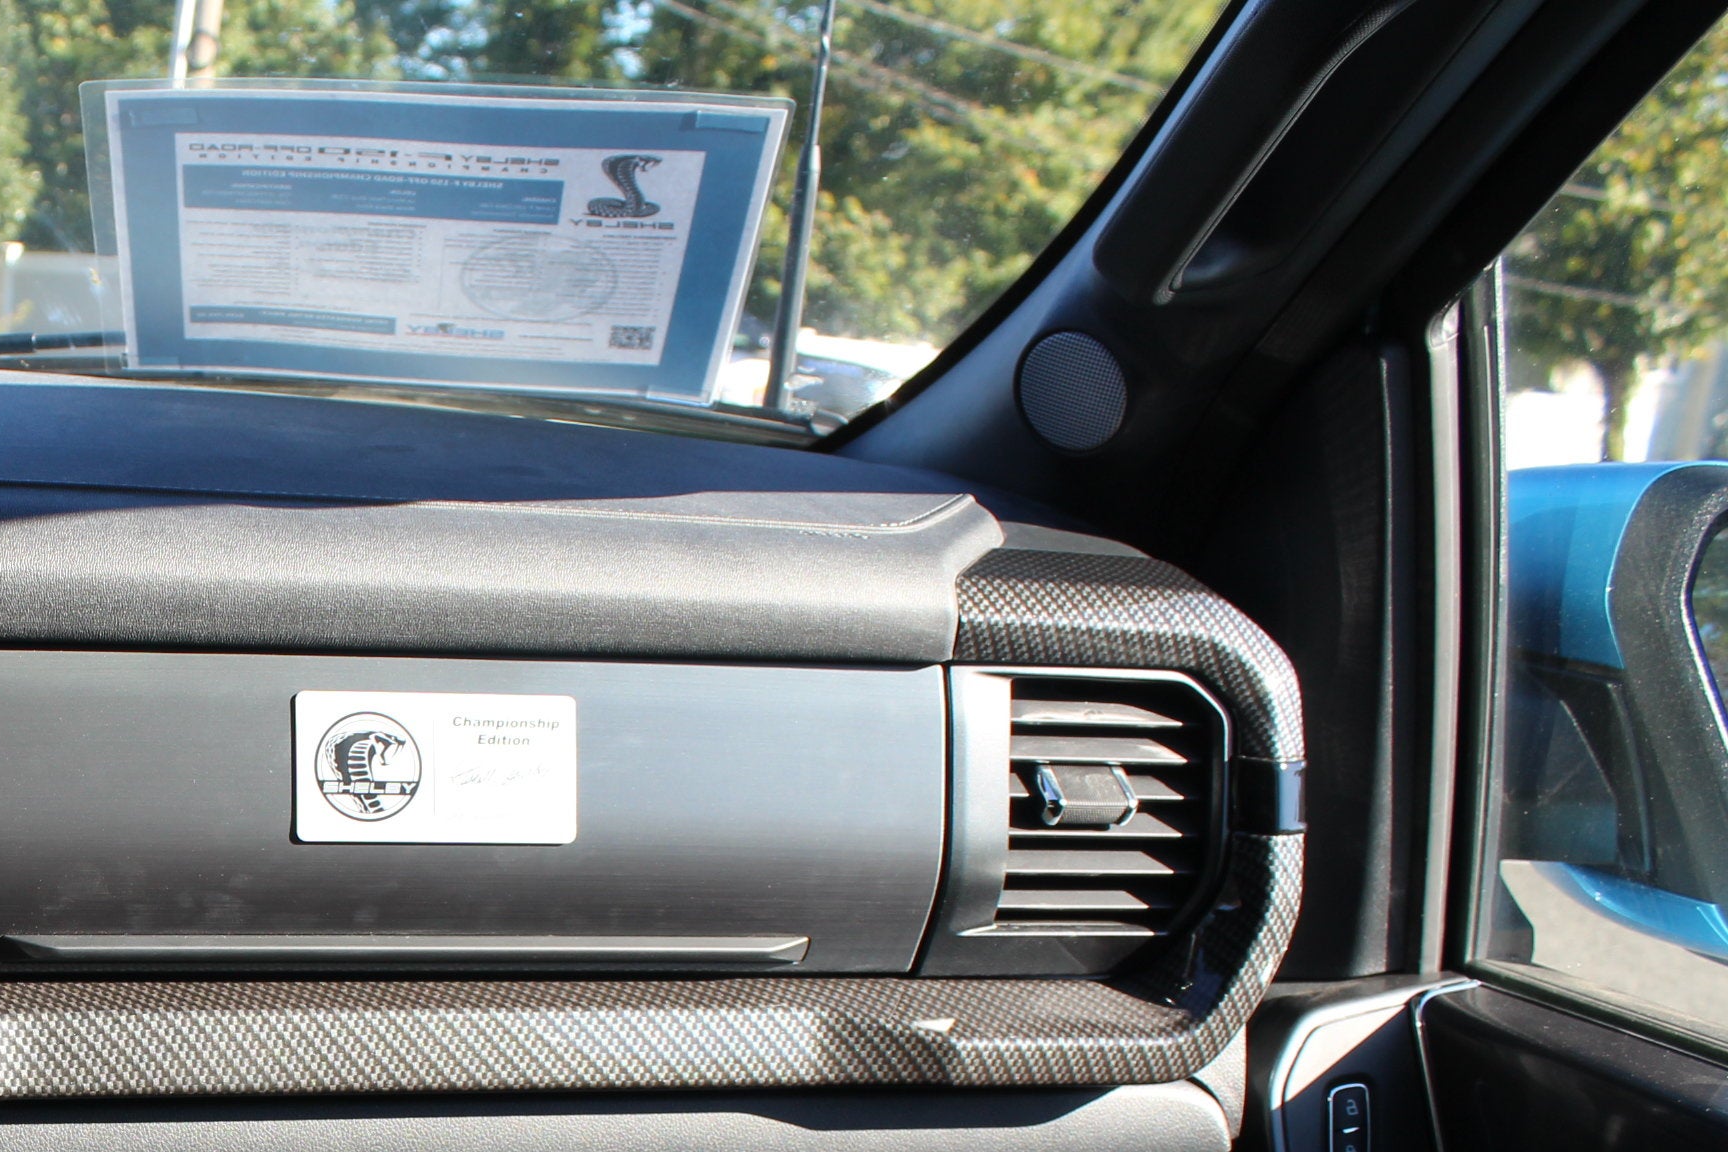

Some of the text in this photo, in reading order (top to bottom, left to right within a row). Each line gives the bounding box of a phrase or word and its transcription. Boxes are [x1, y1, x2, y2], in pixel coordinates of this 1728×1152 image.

[452, 715, 560, 731] Championship
[477, 734, 530, 746] Edition
[323, 781, 417, 794] SHELBY
